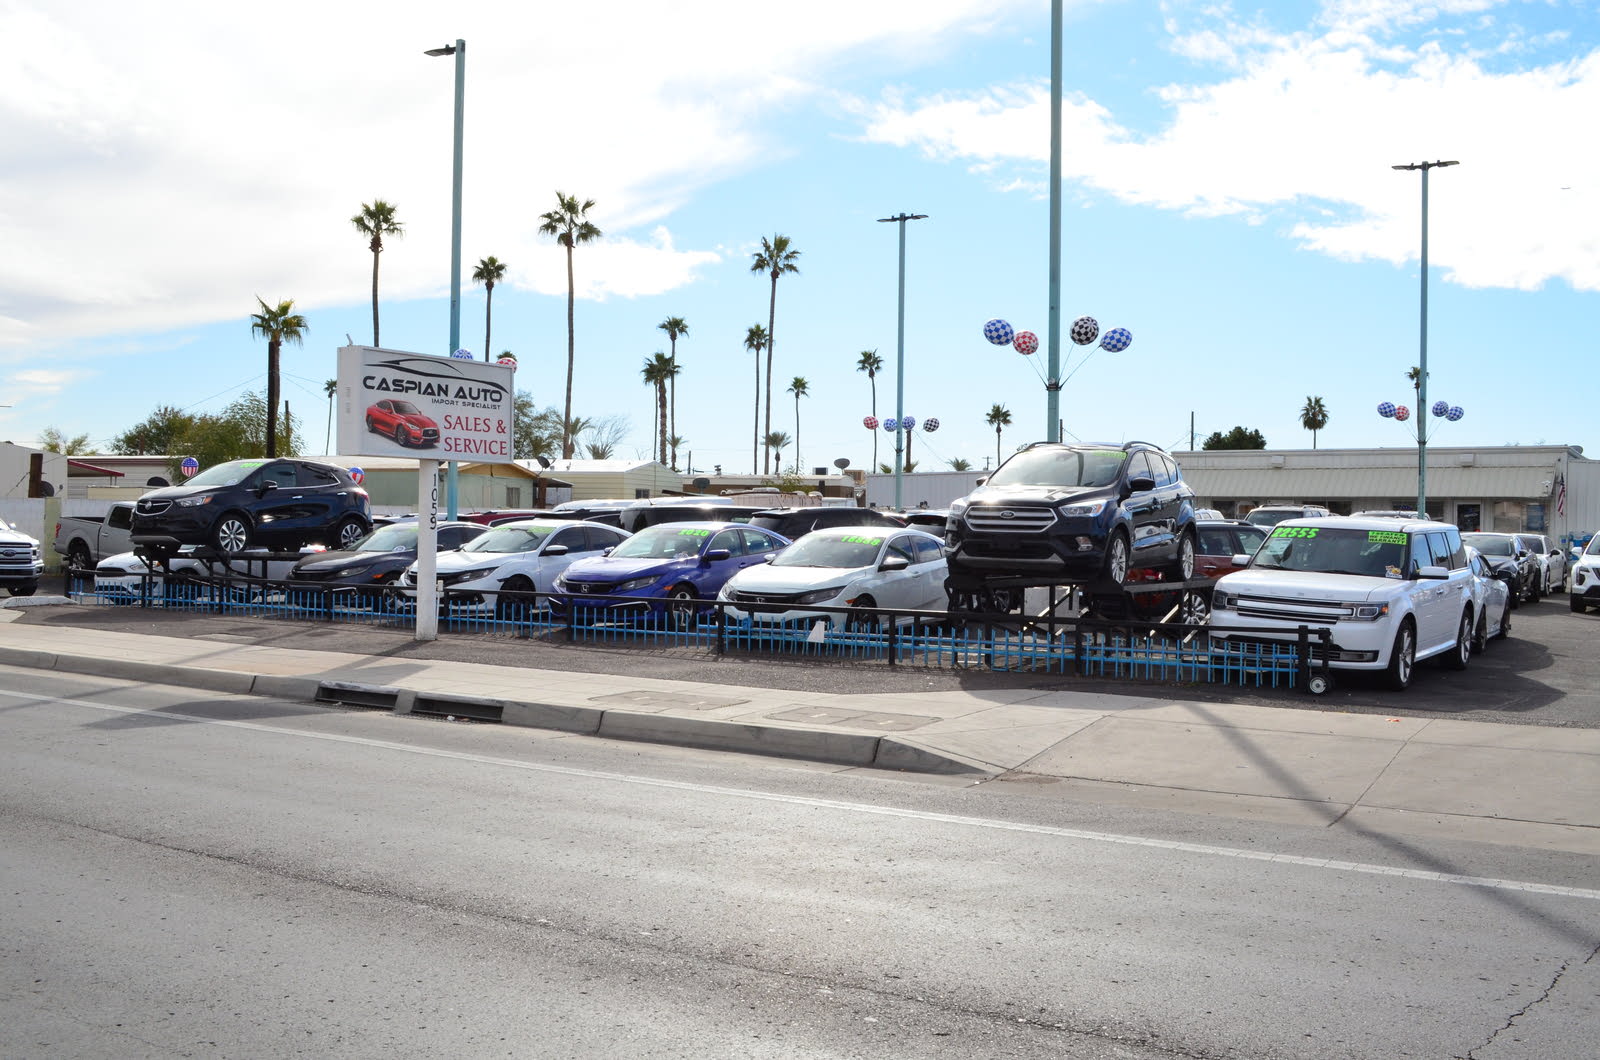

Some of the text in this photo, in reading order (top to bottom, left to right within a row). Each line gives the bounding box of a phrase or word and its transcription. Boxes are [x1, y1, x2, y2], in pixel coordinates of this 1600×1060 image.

[362, 375, 503, 403] CASPIAN AUTO
[431, 398, 501, 410] IMPORT SPECIALIST
[443, 414, 506, 434] SALES &
[444, 436, 508, 456] SERVICE
[1271, 527, 1320, 539] 22555
